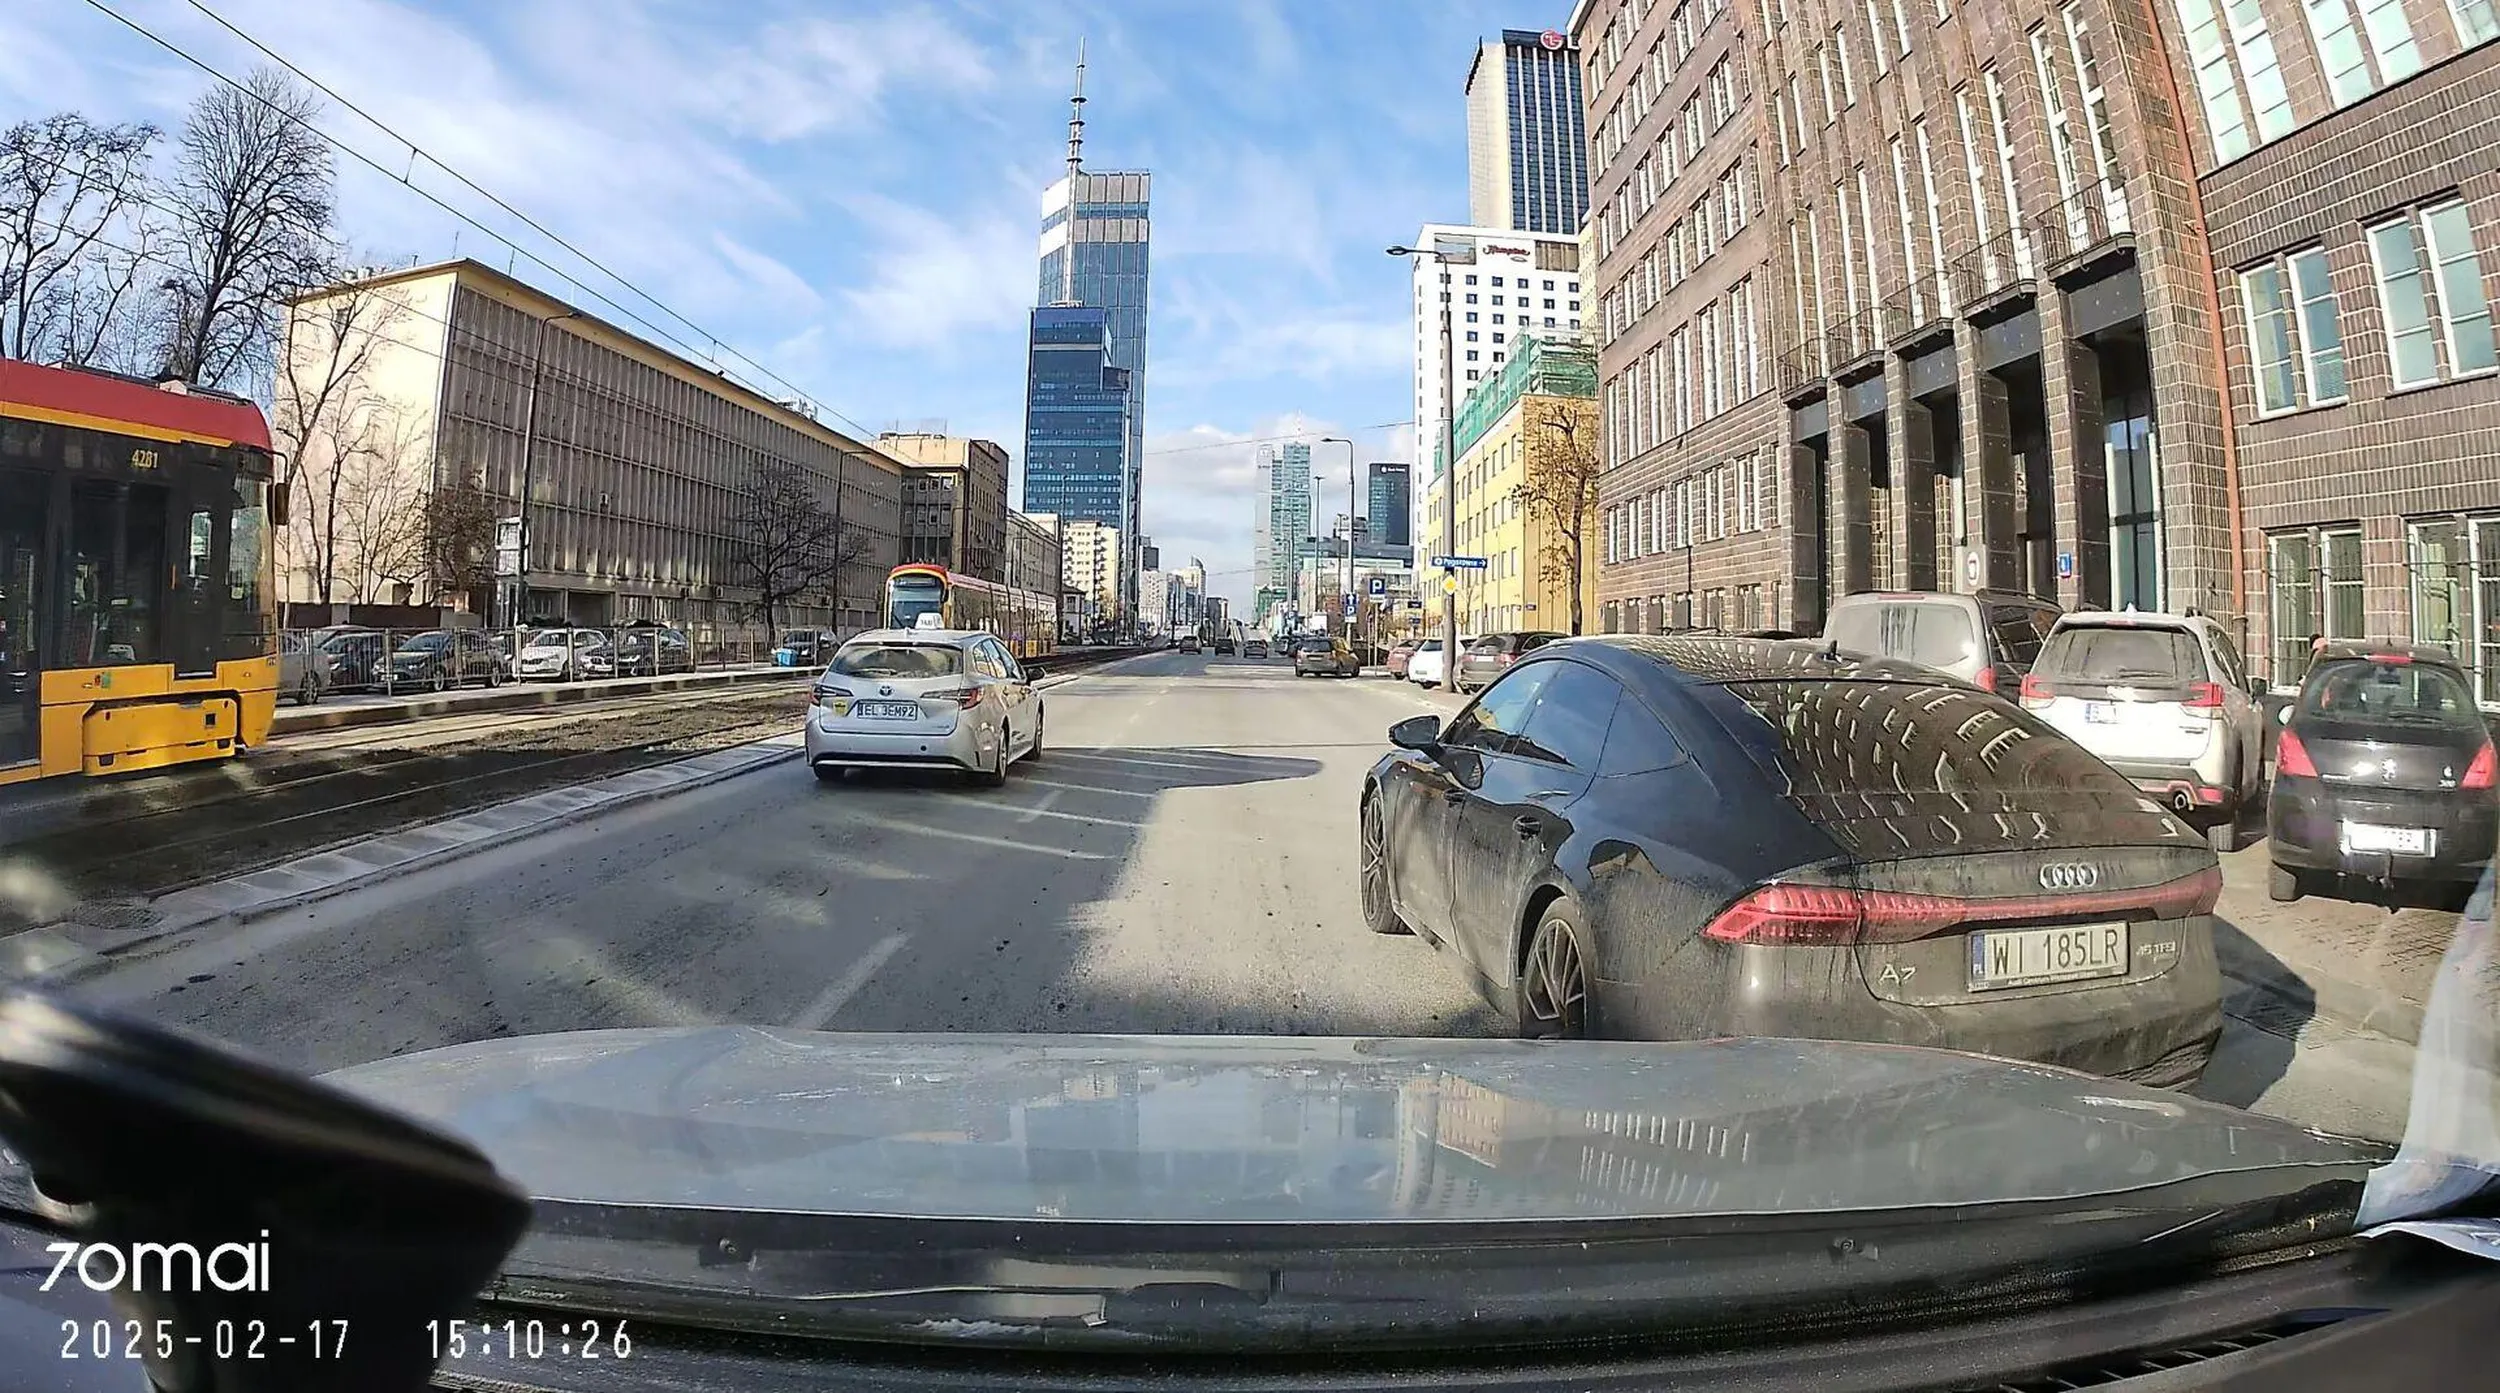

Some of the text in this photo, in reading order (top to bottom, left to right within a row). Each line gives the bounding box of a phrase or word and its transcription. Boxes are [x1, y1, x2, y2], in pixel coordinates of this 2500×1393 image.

[132, 449, 158, 469] 4281
[1371, 579, 1383, 593] P
[1347, 606, 1355, 615] P
[865, 705, 877, 716] EL
[1992, 929, 2118, 975] WI 185LR
[1879, 963, 1916, 984] A7
